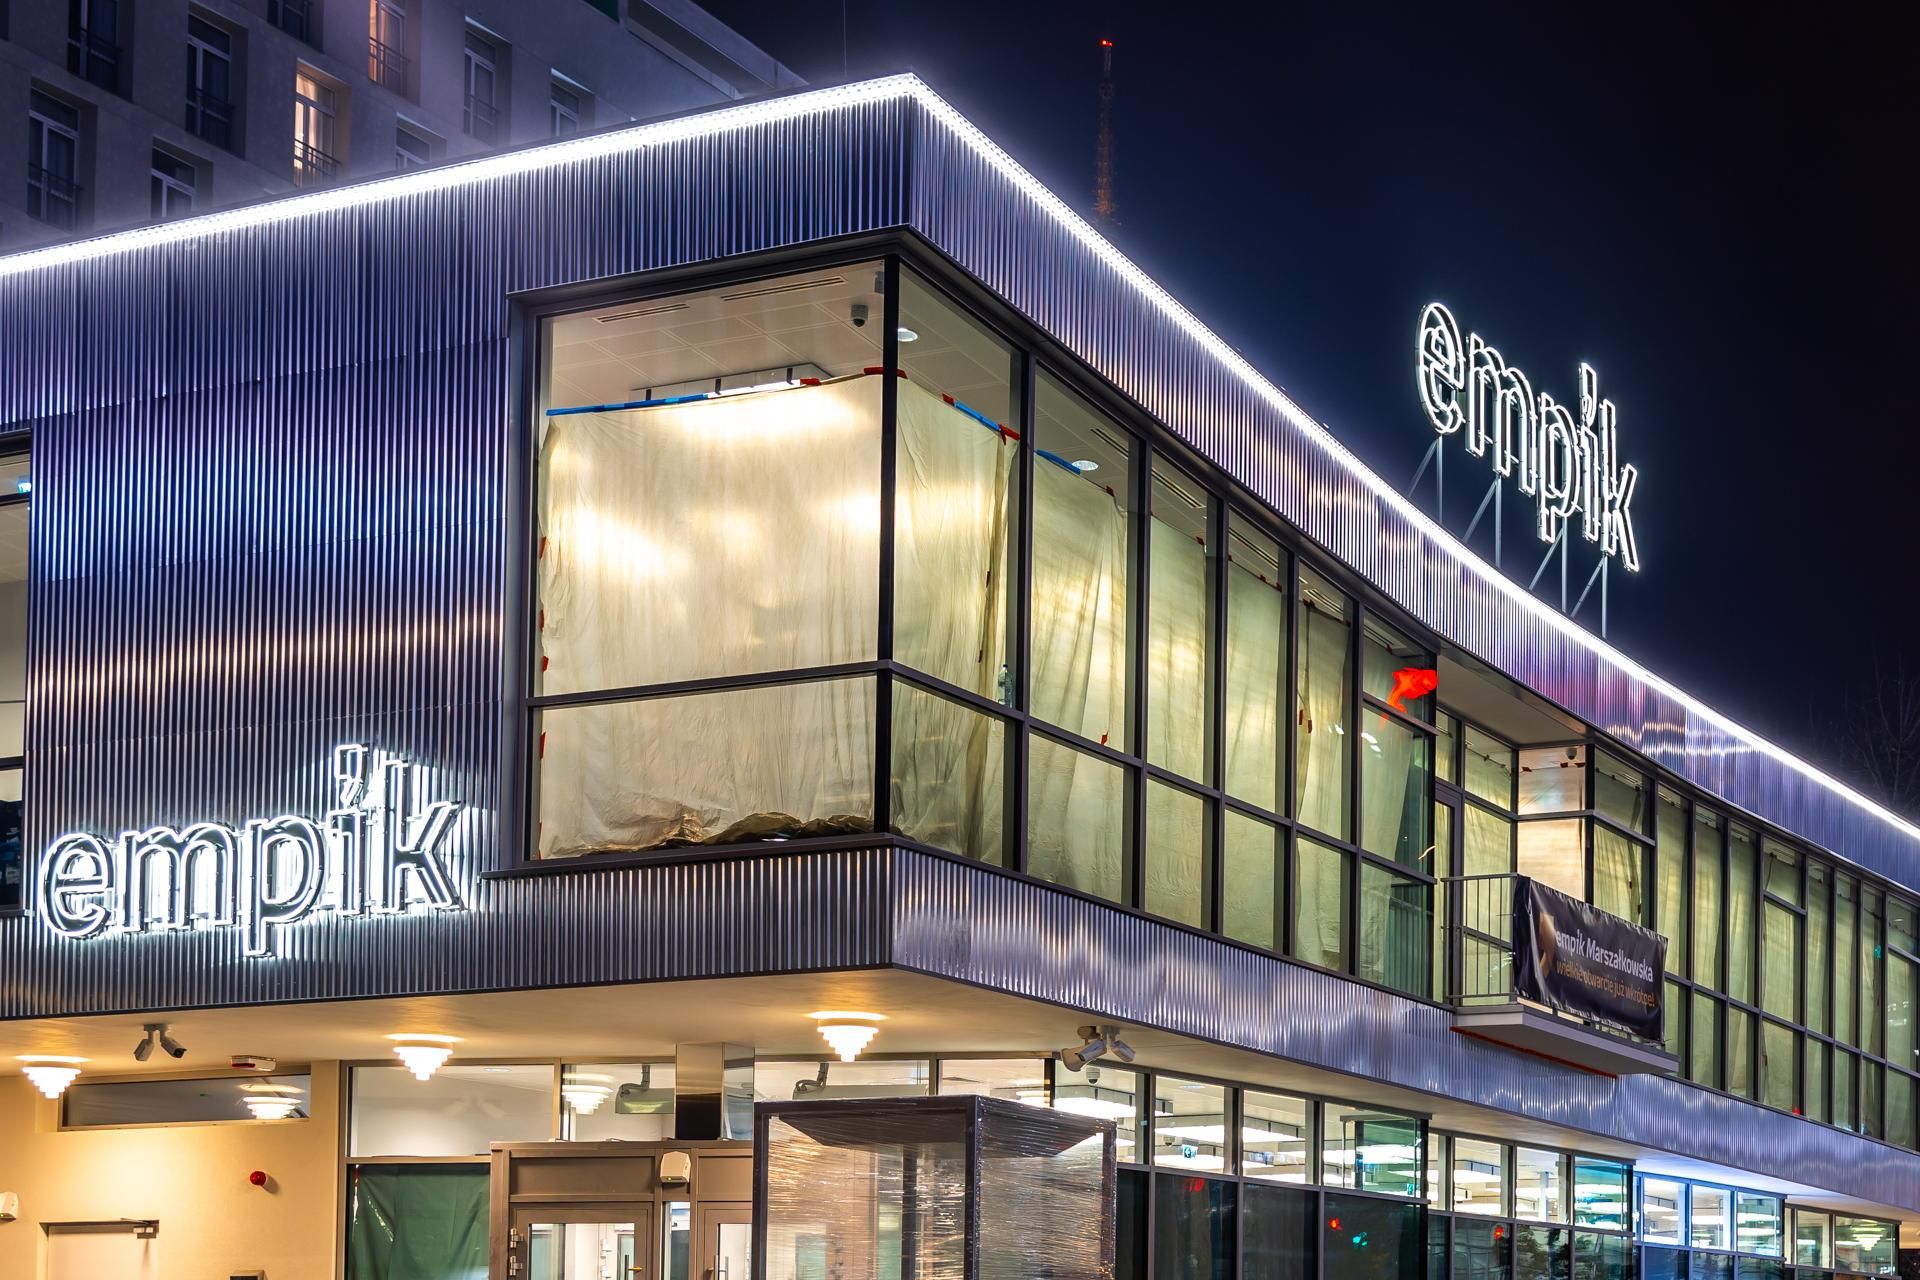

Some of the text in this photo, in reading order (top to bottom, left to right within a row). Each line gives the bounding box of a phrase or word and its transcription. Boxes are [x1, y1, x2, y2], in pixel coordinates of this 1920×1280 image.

[1416, 302, 1639, 572] empik
[39, 743, 463, 957] empik
[1555, 929, 1654, 983] empik Marszałkowska
